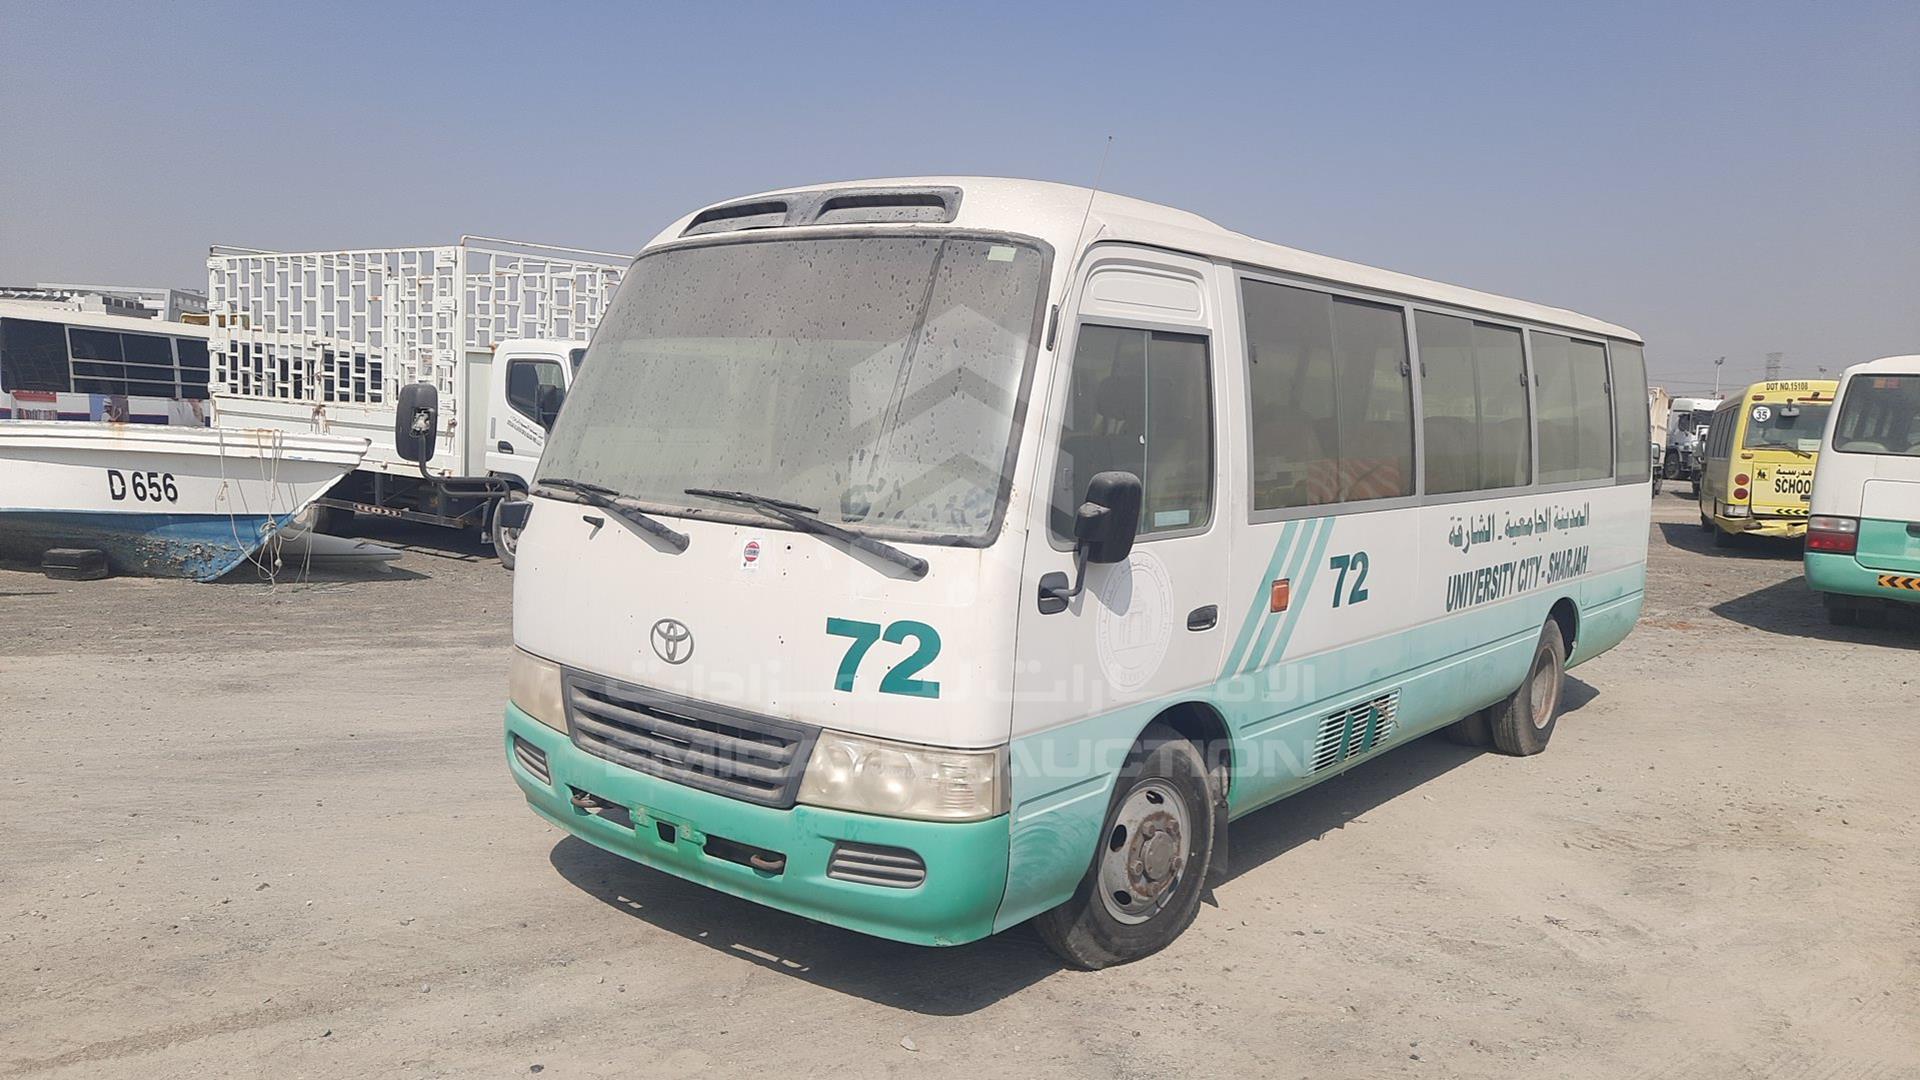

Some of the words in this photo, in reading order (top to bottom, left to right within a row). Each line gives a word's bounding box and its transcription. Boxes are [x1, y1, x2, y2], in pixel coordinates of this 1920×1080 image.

[1766, 382, 1778, 391] DOT
[1756, 411, 1768, 420] 35
[107, 469, 126, 501] D
[132, 471, 178, 503] 656
[1774, 478, 1812, 494] SCHOO
[1448, 513, 1496, 554] الشارقة
[1504, 506, 1552, 546] الجامعية
[1553, 502, 1590, 535] المدينة
[1330, 551, 1369, 609] 72
[1446, 561, 1517, 612] UNIVERSITY
[1518, 556, 1542, 592] CITY
[1547, 546, 1588, 583] SHARJAH
[826, 616, 941, 699] 72
